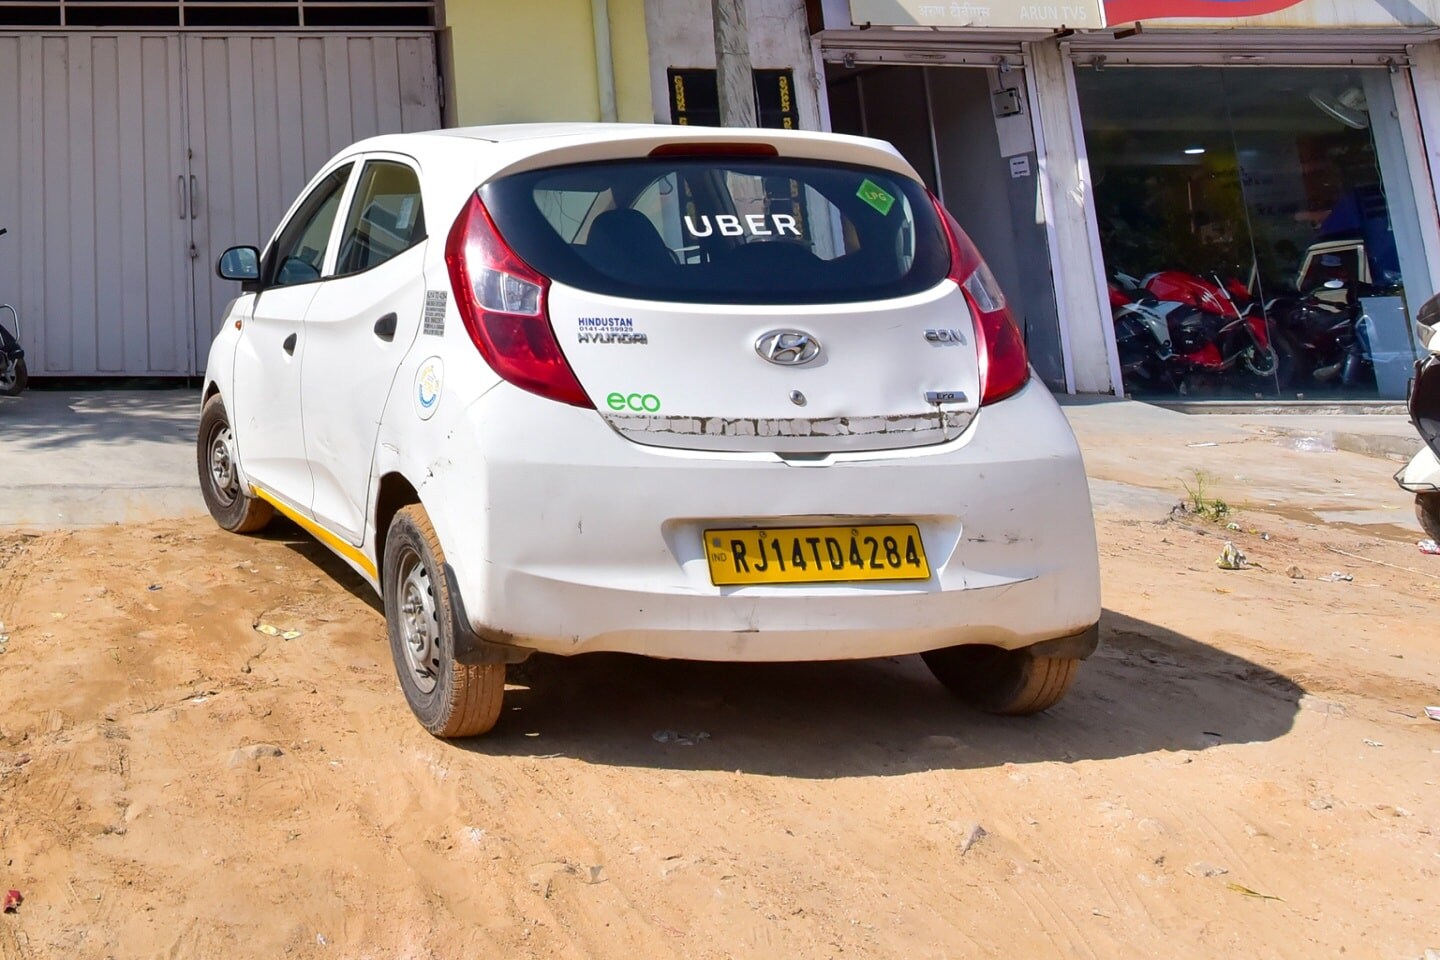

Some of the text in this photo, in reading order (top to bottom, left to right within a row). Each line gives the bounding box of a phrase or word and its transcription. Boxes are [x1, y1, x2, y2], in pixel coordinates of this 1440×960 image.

[1019, 5, 1088, 21] ARUN TVS
[864, 191, 887, 201] LPG
[684, 213, 802, 238] UBER
[578, 317, 633, 327] HINDUSTAN
[578, 332, 649, 345] HYUNDAI
[923, 328, 966, 344] EON
[606, 392, 662, 413] eco
[936, 392, 955, 400] Era
[711, 553, 727, 562] IND
[730, 534, 922, 574] RJ14TD4284
